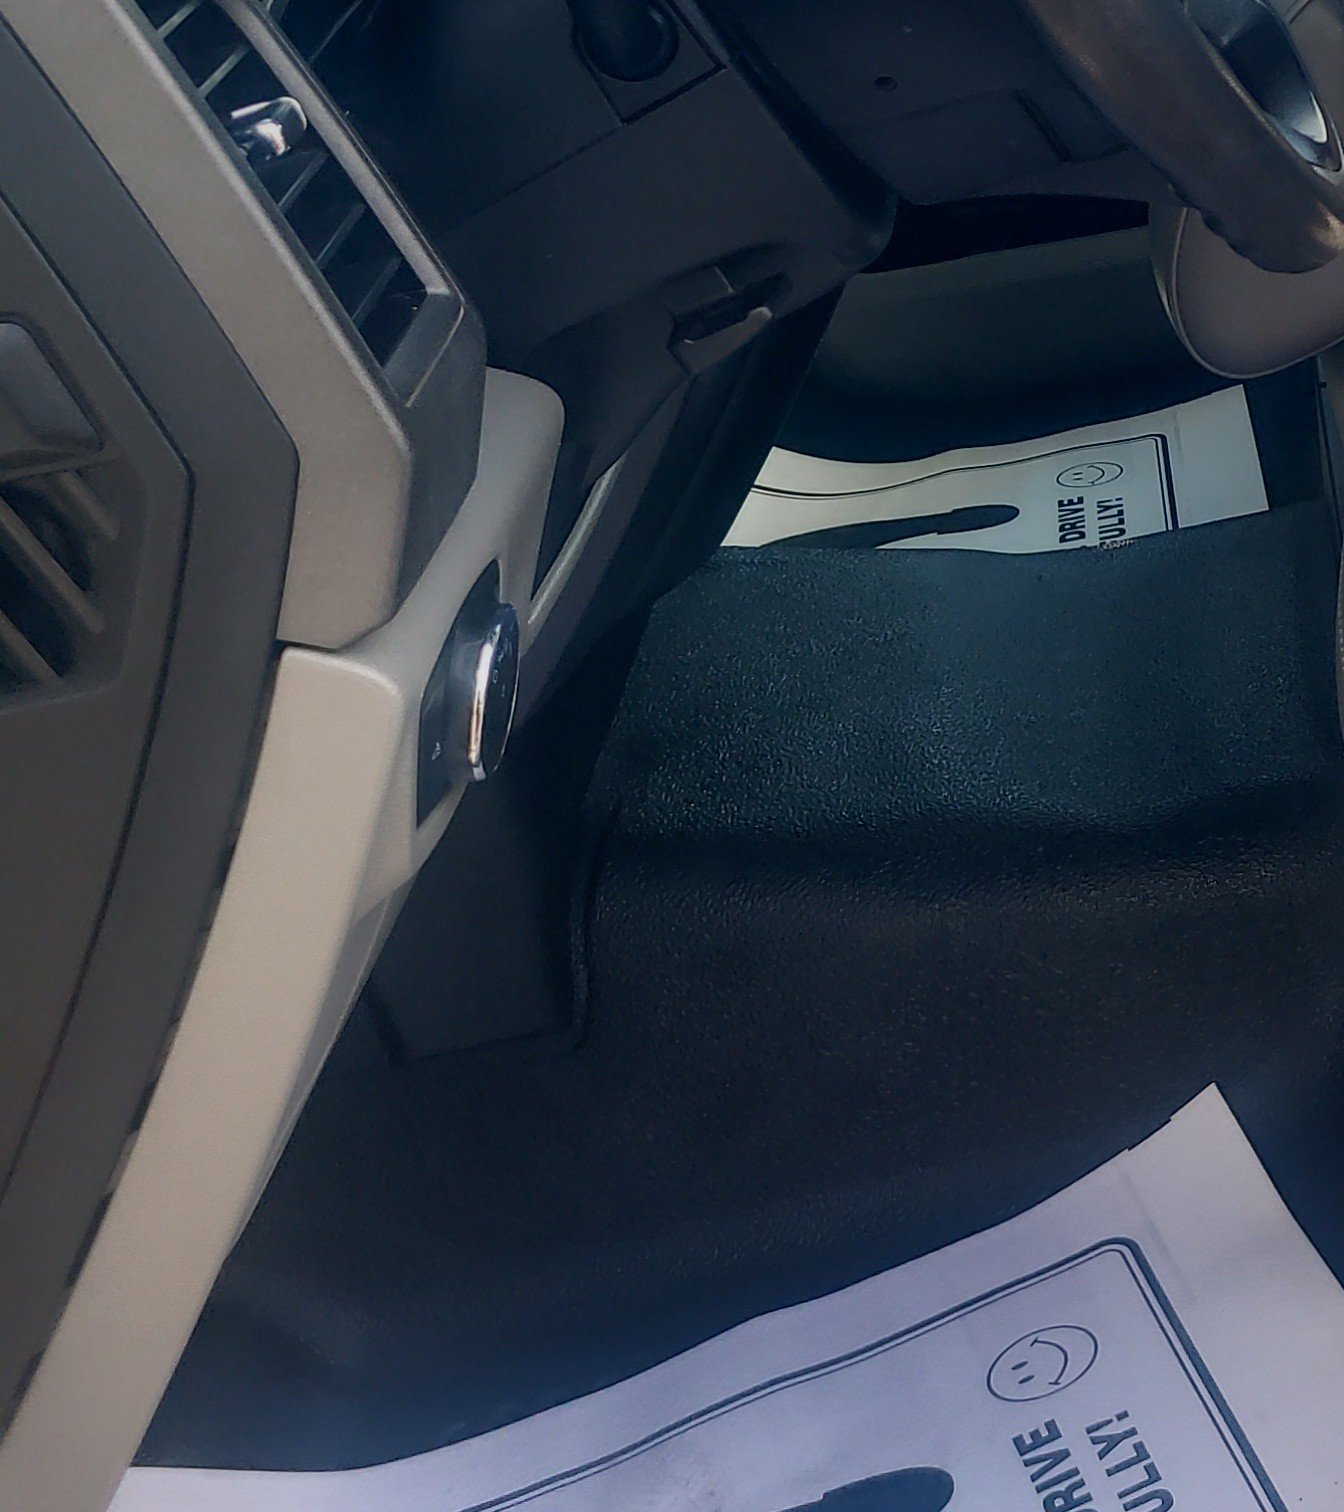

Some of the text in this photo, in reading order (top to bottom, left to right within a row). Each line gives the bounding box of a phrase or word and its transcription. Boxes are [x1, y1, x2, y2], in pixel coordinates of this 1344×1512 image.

[1058, 496, 1086, 543] DRIVE
[1097, 497, 1126, 547] ULLY!
[1012, 1418, 1099, 1512] RIVE
